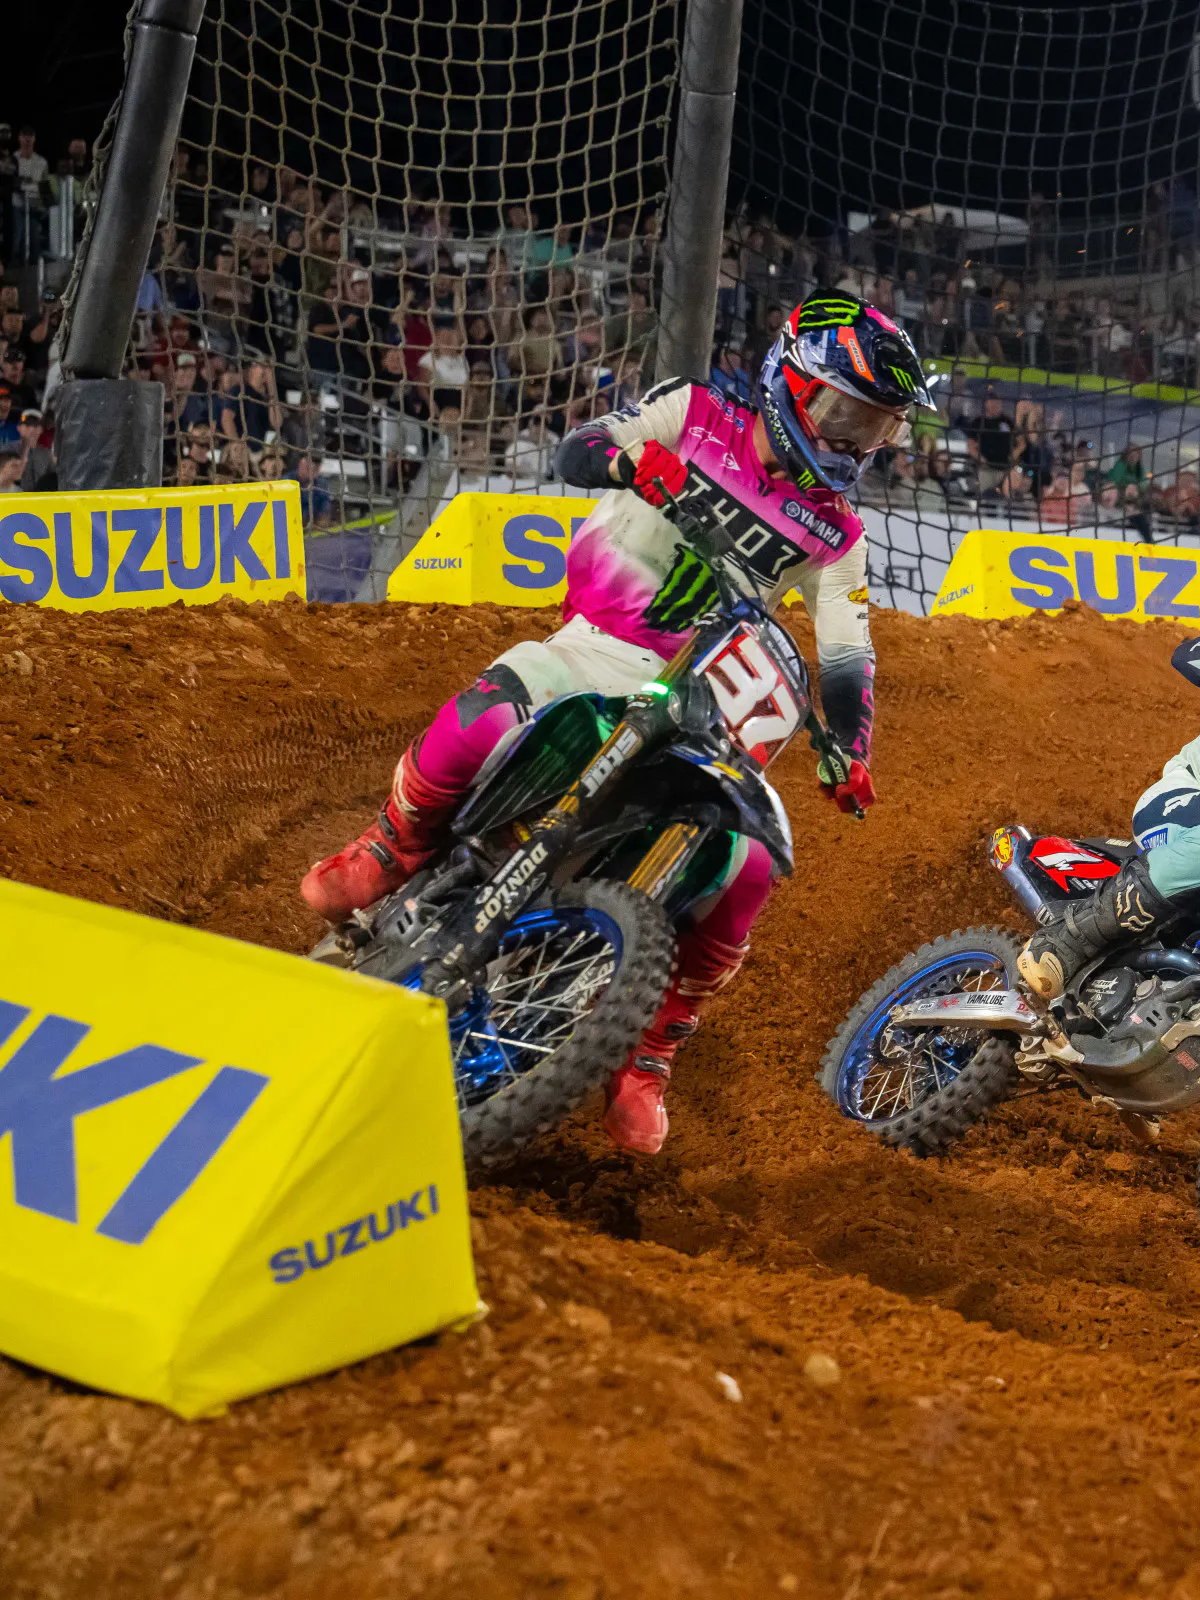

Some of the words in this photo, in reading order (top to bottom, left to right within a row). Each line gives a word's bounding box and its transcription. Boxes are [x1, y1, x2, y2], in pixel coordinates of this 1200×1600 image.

[0, 500, 291, 604] SUZUKI
[413, 557, 463, 570] SUZUKI
[937, 583, 975, 608] SUZUKI
[705, 637, 800, 751] 37
[475, 842, 549, 934] DUNLOP
[966, 994, 1007, 1006] YAMALUBE
[0, 1000, 272, 1246] KI
[268, 1184, 440, 1283] SUZUKI
